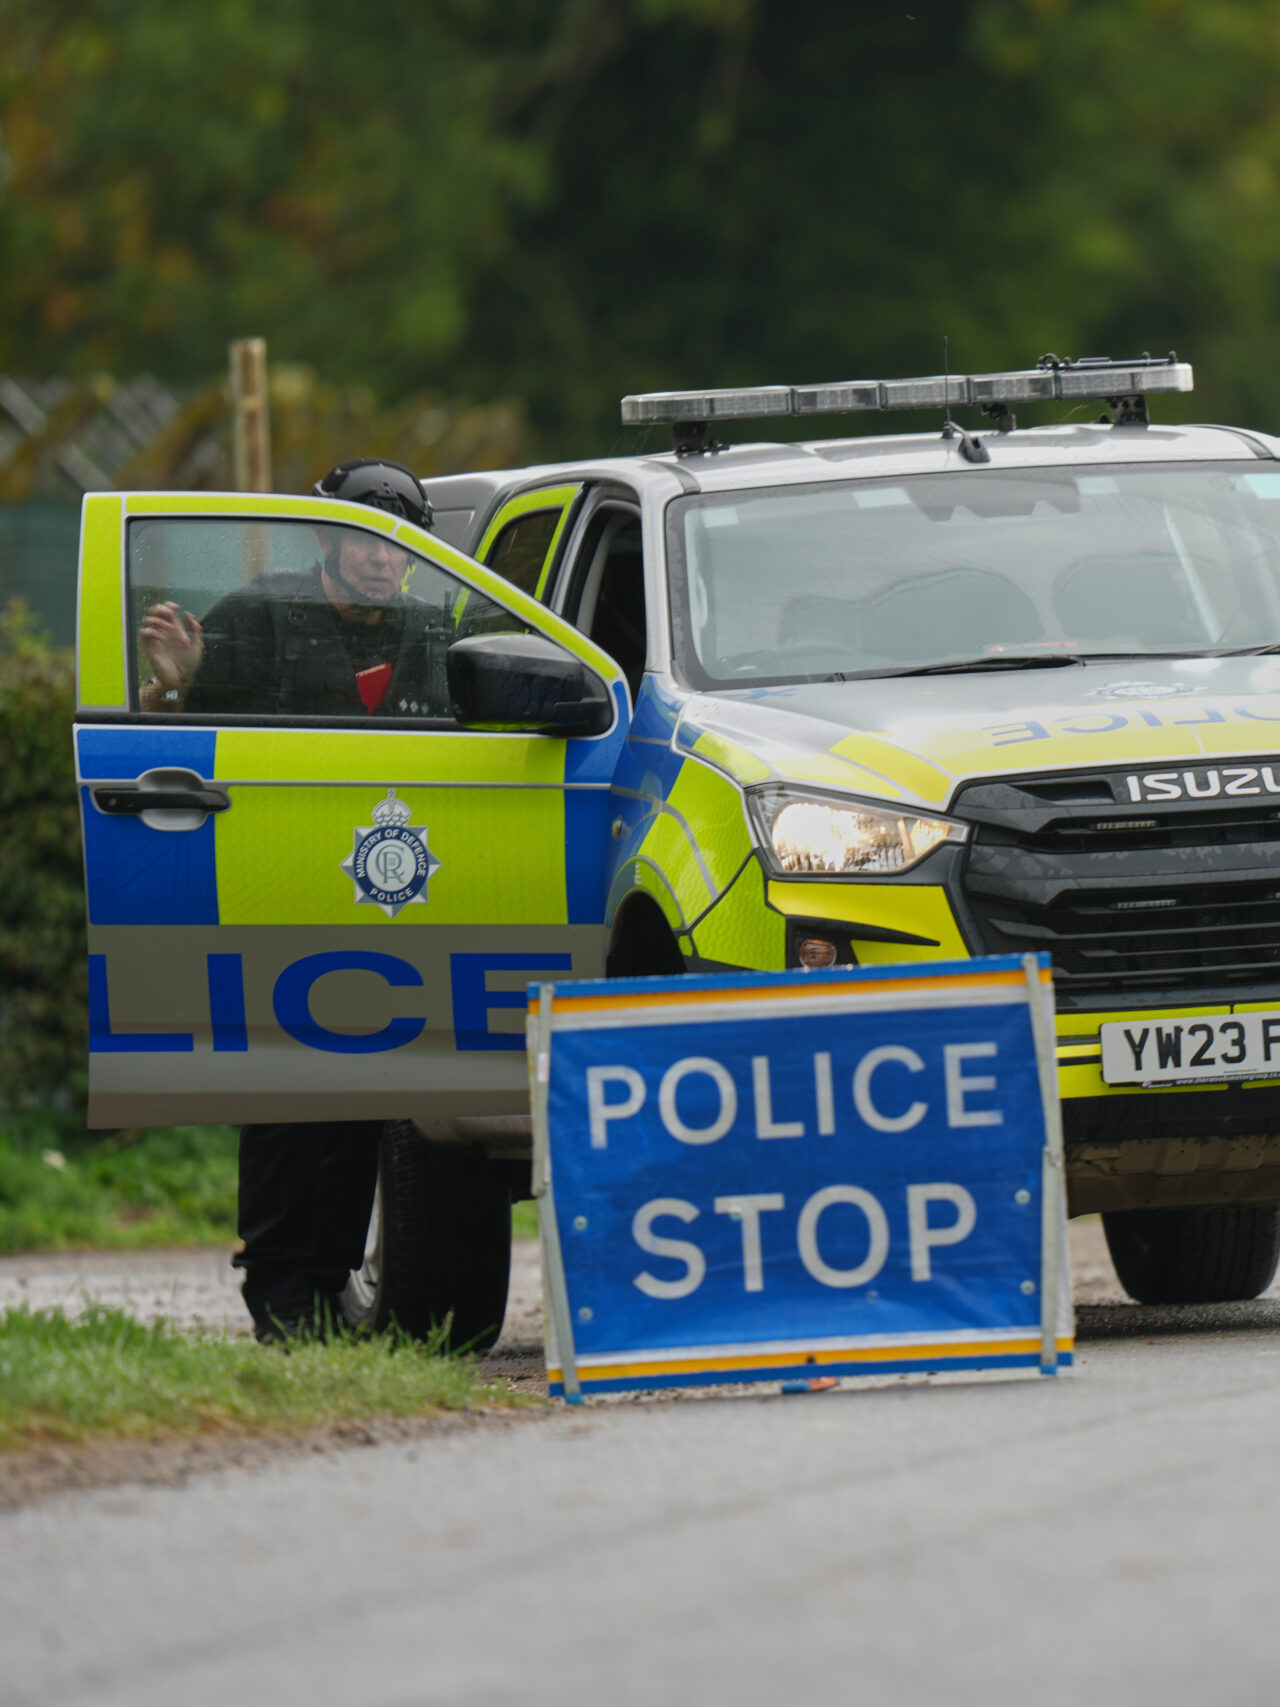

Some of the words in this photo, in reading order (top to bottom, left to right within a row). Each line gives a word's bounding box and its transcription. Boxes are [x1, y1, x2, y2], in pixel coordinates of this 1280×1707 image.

[356, 831, 383, 878] MINISTRY
[384, 828, 401, 839] OF
[400, 831, 427, 877] DEFENCE
[369, 887, 414, 902] POLICE
[1123, 1021, 1247, 1071] YW23
[586, 1042, 1003, 1150] POLICE
[631, 1182, 977, 1300] STOP
